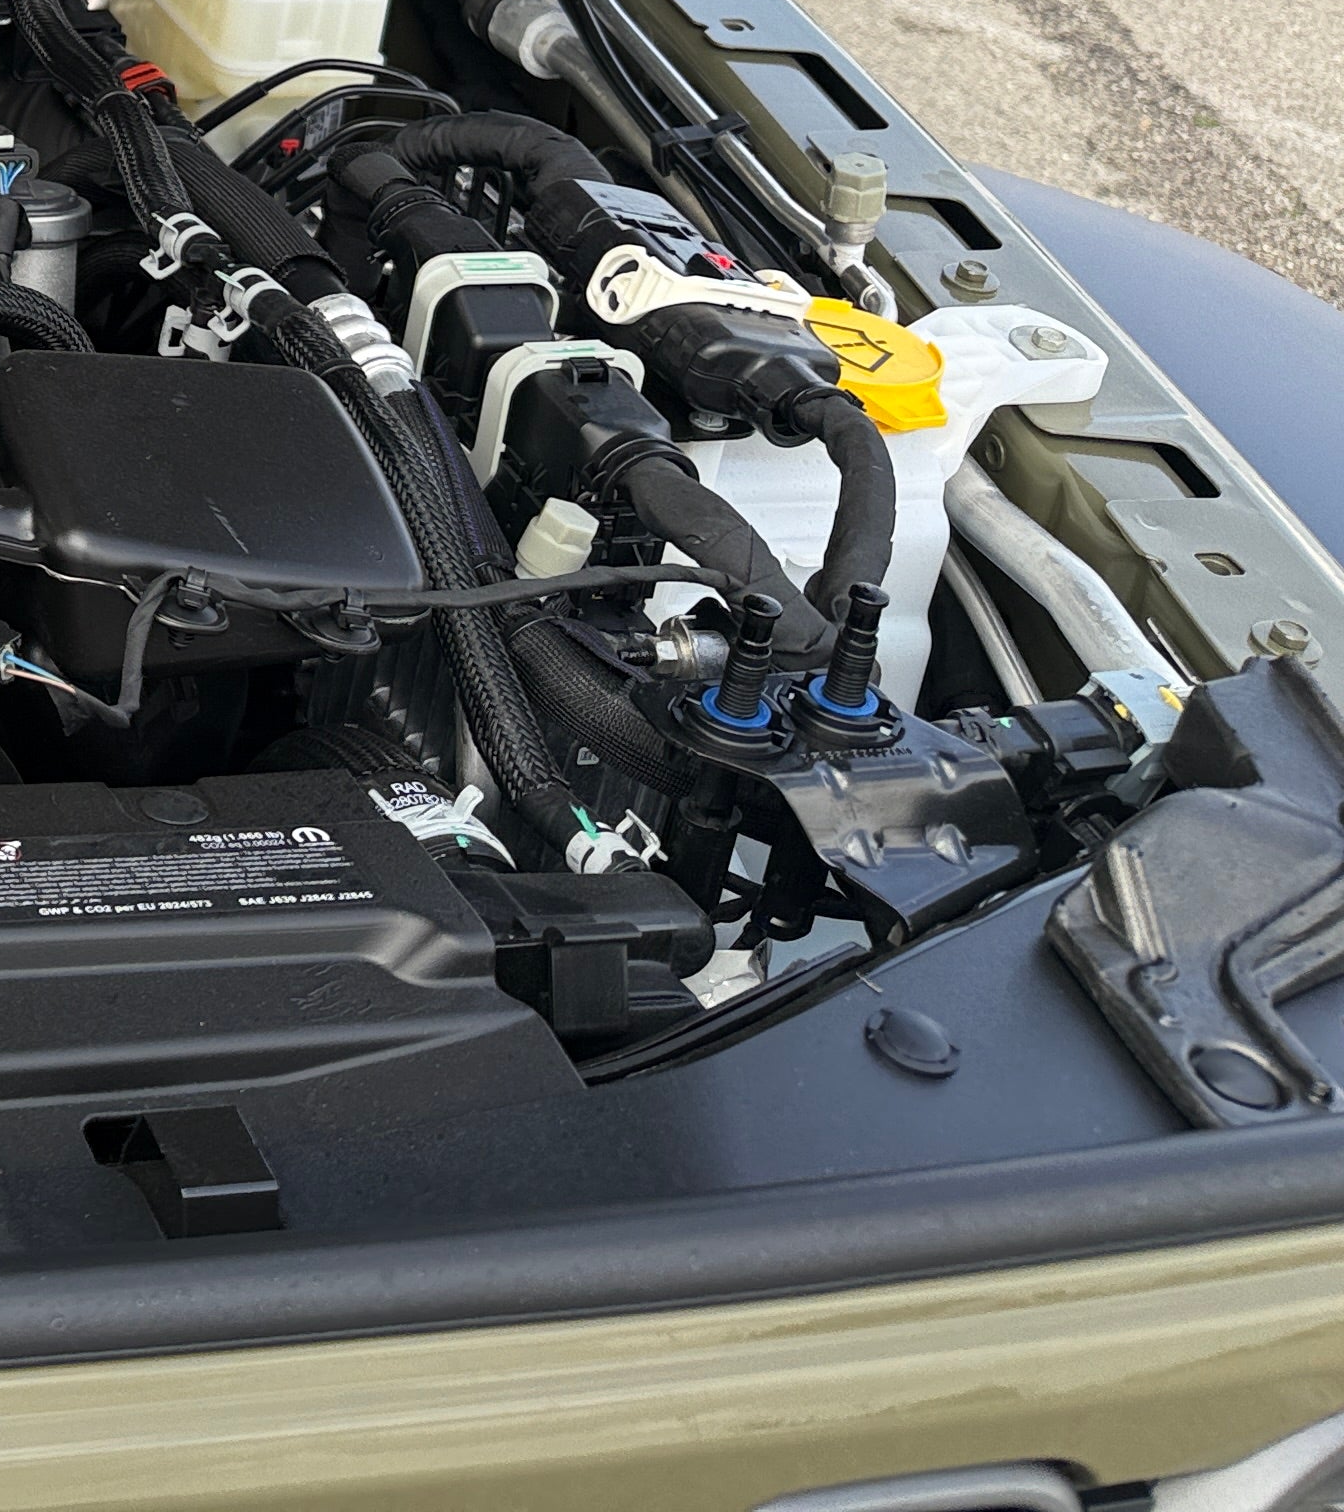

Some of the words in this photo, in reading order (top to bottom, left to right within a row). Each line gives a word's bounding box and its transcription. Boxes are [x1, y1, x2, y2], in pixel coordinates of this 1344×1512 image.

[389, 781, 428, 795] RAD
[39, 906, 70, 916] GWP
[72, 906, 84, 914] &
[85, 904, 113, 913] CO2
[114, 904, 136, 914] per
[137, 901, 156, 911] EU
[158, 899, 213, 910] 2024/573
[238, 896, 266, 906] SAE
